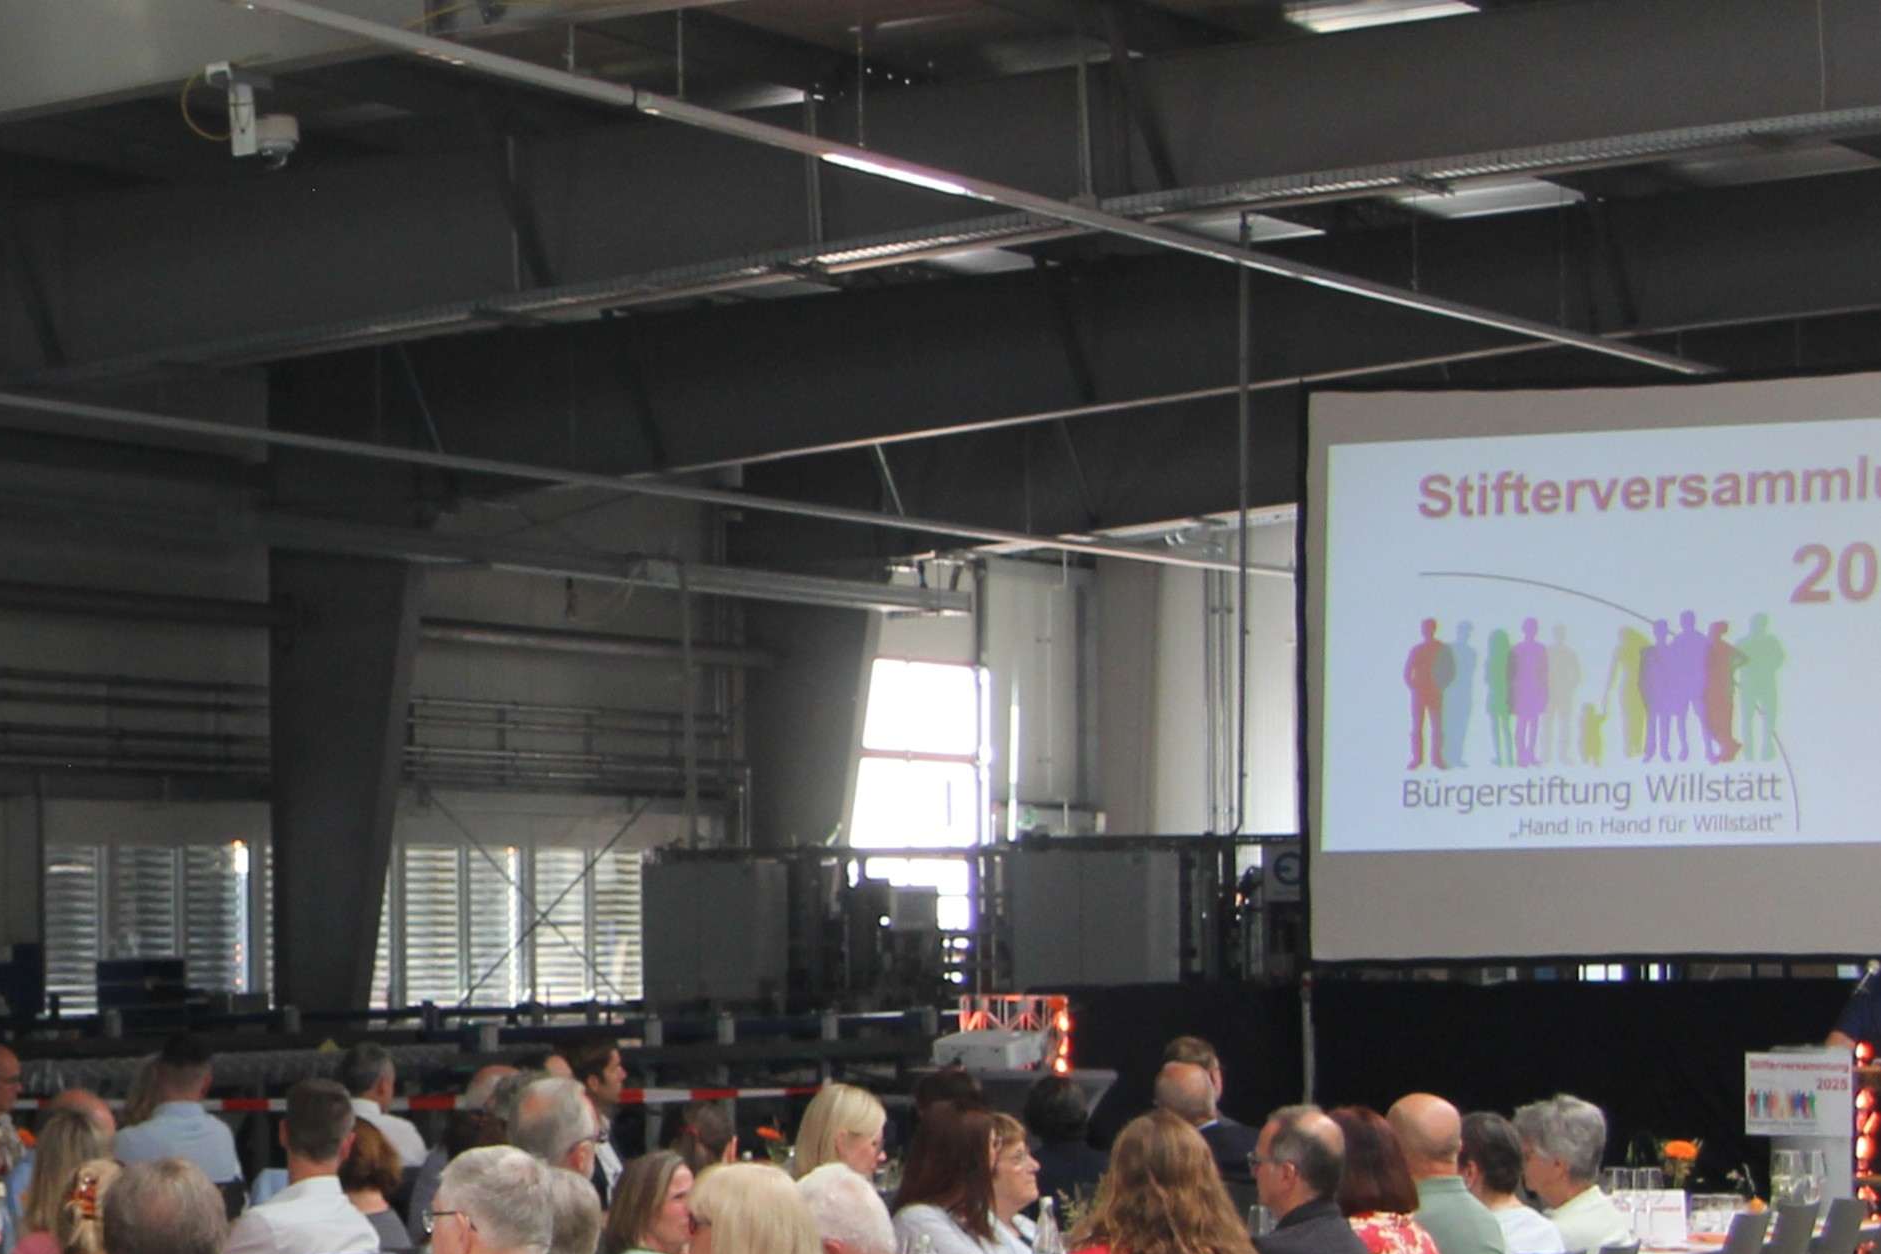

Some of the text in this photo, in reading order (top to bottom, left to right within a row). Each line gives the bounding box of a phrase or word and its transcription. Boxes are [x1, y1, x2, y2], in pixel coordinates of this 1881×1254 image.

[1418, 455, 1881, 518] Stifterversamml
[1790, 540, 1880, 605] 20
[1402, 772, 1783, 813] Bürgerstiftung Willstätt
[1576, 816, 1594, 834] in
[1600, 815, 1651, 835] Hand
[1659, 814, 1687, 834] für
